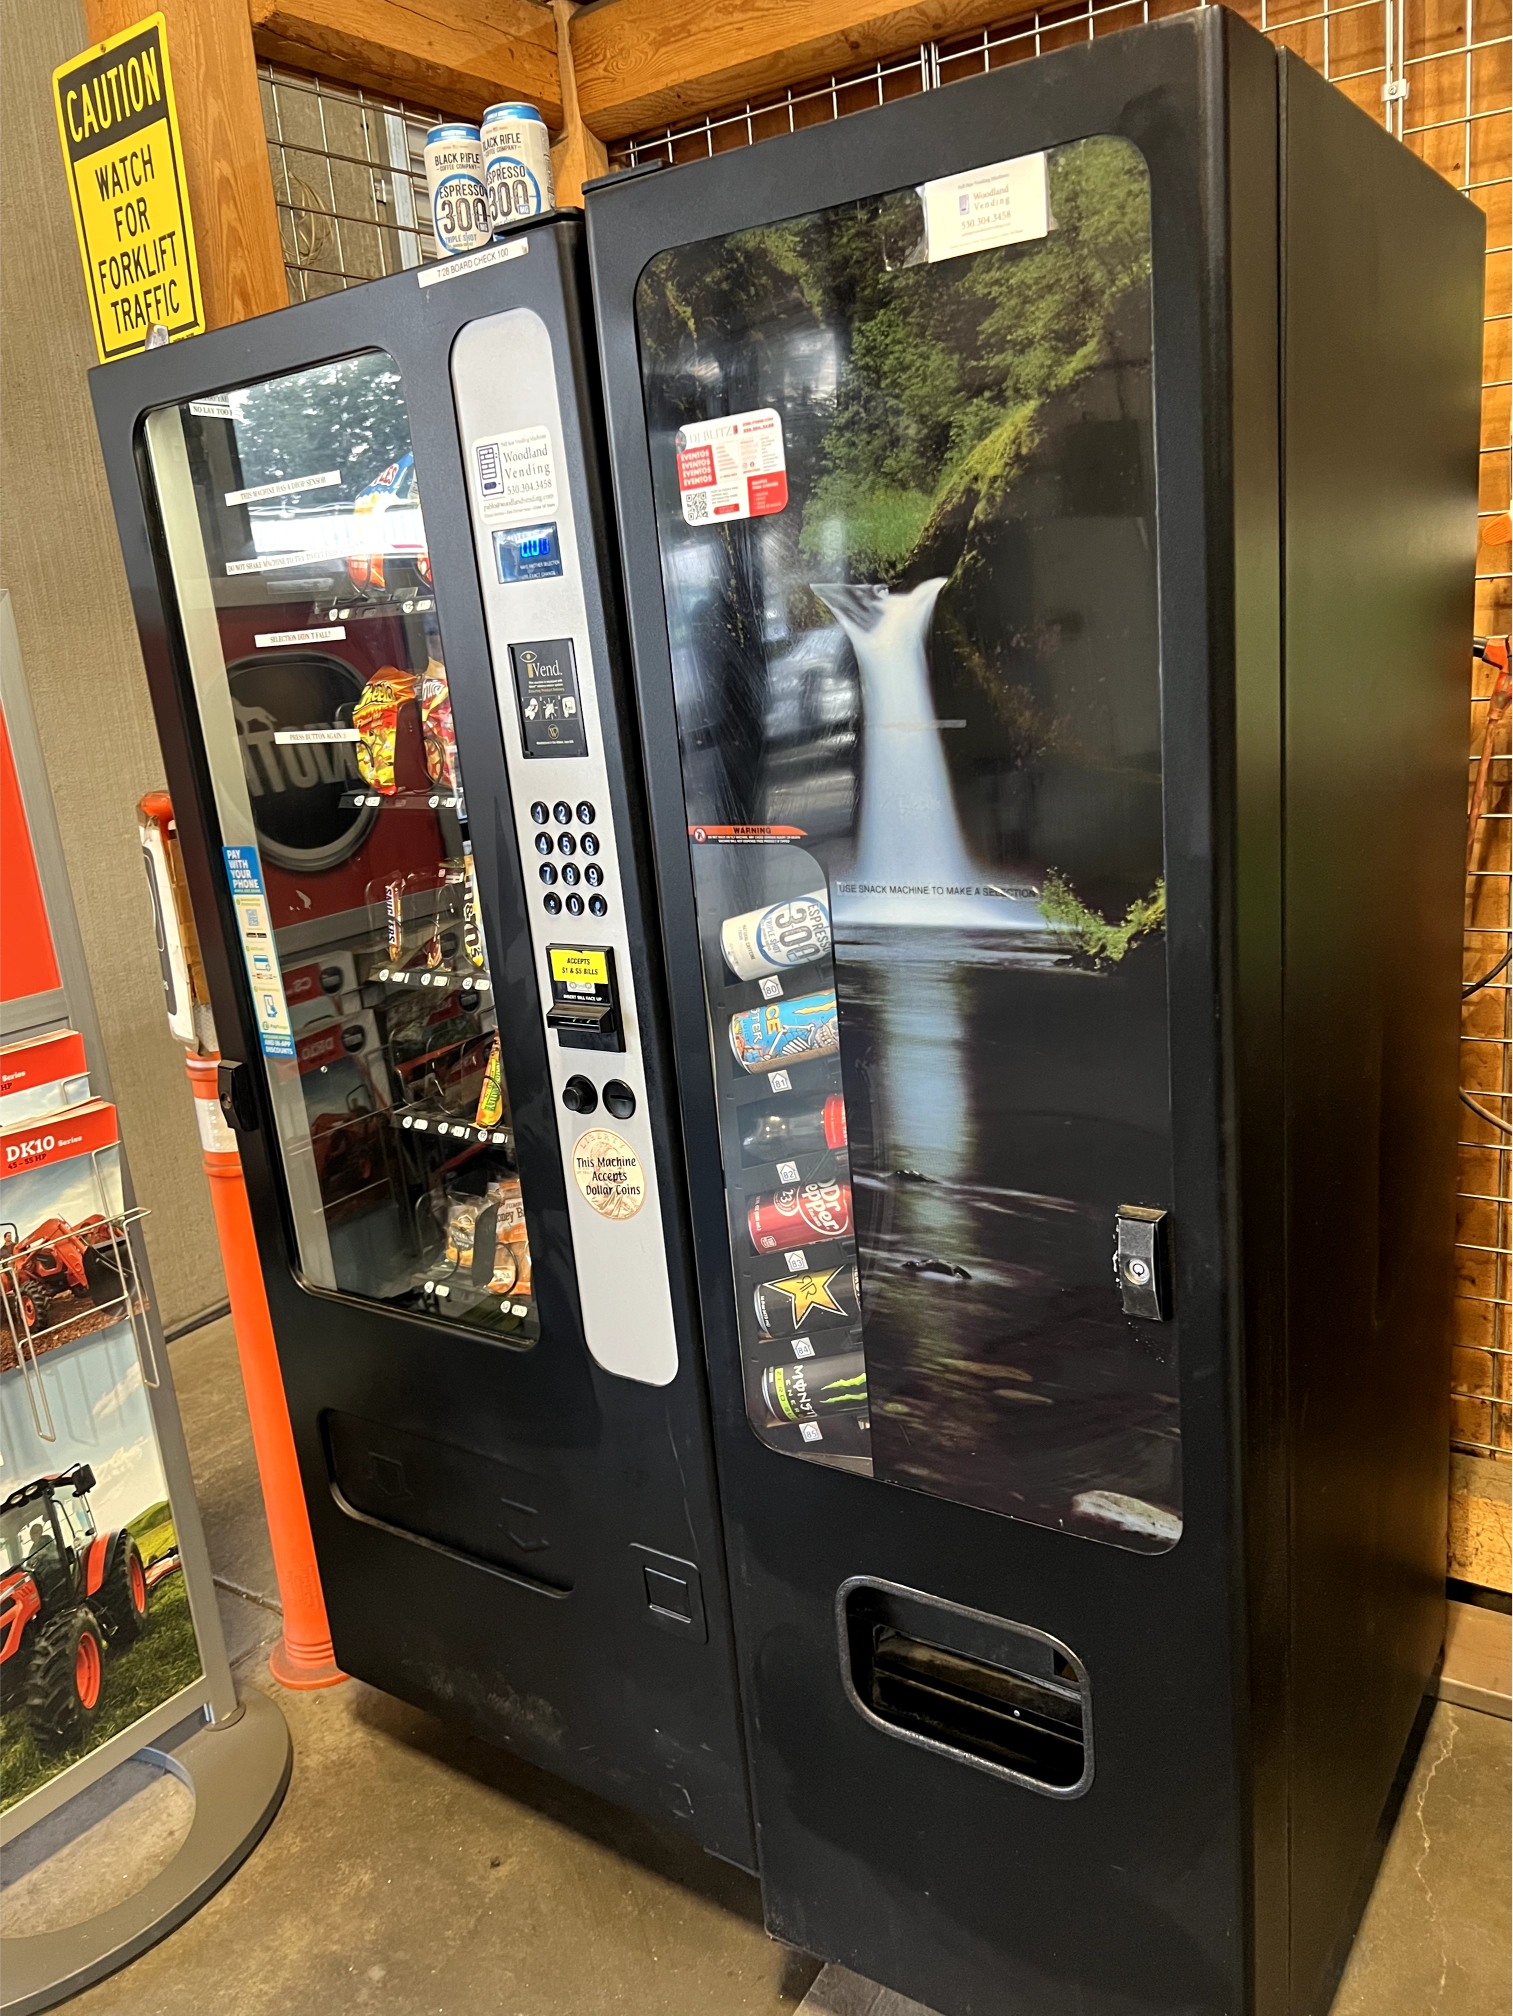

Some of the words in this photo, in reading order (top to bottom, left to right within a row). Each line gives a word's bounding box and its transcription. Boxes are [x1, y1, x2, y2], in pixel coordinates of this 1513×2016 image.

[66, 46, 161, 143] CAUTION
[500, 133, 521, 145] RIFLE
[435, 153, 458, 166] BLACK
[460, 153, 480, 164] RIFLE
[95, 144, 155, 202] WATCH
[439, 184, 485, 199] ESPRESSO
[973, 184, 1010, 201] Woodland
[487, 179, 529, 221] 300
[974, 196, 1010, 211] Vending
[113, 196, 150, 242] FOR
[441, 198, 488, 234] 300
[961, 210, 1012, 230] 530.304.3458
[445, 234, 460, 244] TRIPLE
[463, 233, 477, 242] SHOT
[98, 231, 178, 294] FORKLIFT
[450, 259, 473, 274] BOARD
[473, 252, 497, 267] CHECK
[497, 247, 509, 259] 100
[111, 278, 180, 334] TRAFFIC
[690, 434, 701, 444] DJ
[703, 426, 733, 440] BLITZ
[503, 444, 548, 463] Woodland
[681, 449, 710, 462] EVENTOS
[682, 458, 711, 470] EVENTOS
[504, 463, 551, 479] Vending
[683, 467, 712, 478] EVENTOS
[507, 479, 553, 496] 530.304.3458
[684, 475, 713, 487] EVENTOS
[240, 492, 252, 501] THIS
[253, 488, 275, 499] MACHINE
[306, 476, 327, 487] SENSOR
[228, 564, 235, 572] DO
[236, 563, 245, 571] NOT
[246, 562, 262, 570] SHAKE
[270, 634, 297, 643] SELECTION
[305, 733, 326, 741] BUTTON
[536, 805, 543, 819] 1
[559, 805, 565, 820] 2
[581, 805, 589, 821] 3
[539, 837, 547, 851] 4
[563, 837, 570, 851] 5
[585, 837, 592, 850] 6
[226, 849, 241, 860] PAY
[229, 859, 249, 869] WITH
[230, 869, 251, 879] YOUR
[543, 867, 550, 881] 7
[566, 867, 573, 881] 8
[590, 868, 597, 882] 9
[232, 879, 260, 889] PHONE
[840, 884, 858, 893] USE
[859, 885, 886, 895] SNACK
[889, 885, 929, 895] MACHINE
[931, 886, 944, 895] TO
[946, 886, 972, 896] MAKE
[973, 888, 981, 896] A
[982, 888, 1036, 898] SELECTION
[571, 898, 578, 911] 0
[765, 917, 775, 938] TRIPLE
[807, 903, 831, 953] ESPRESSO
[775, 908, 821, 963] 300
[567, 957, 590, 966] ACCEPTS
[561, 966, 569, 975] $1
[570, 967, 575, 975] &
[576, 968, 583, 976] $5
[584, 968, 599, 977] BILLS
[766, 984, 777, 994] 80
[2, 1071, 26, 1082] Series
[775, 1078, 786, 1088] 81
[0, 1082, 13, 1091] HP
[6, 1135, 55, 1162] DK10
[58, 1136, 83, 1147] Series
[7, 1161, 18, 1170] 45
[24, 1157, 34, 1166] 55
[35, 1153, 47, 1162] HP
[577, 1157, 595, 1169] This
[597, 1157, 637, 1168] Machine
[592, 1170, 628, 1183] Accepts
[783, 1169, 795, 1179] 82
[586, 1184, 613, 1196] Dollar
[616, 1184, 641, 1196] Coins
[780, 1189, 794, 1203] 23
[819, 1184, 841, 1211] Dr
[497, 1211, 514, 1223] oney
[791, 1257, 803, 1267] 83
[798, 1345, 809, 1354] 84
[776, 1370, 786, 1402] ZERO
[806, 1429, 817, 1438] 85
